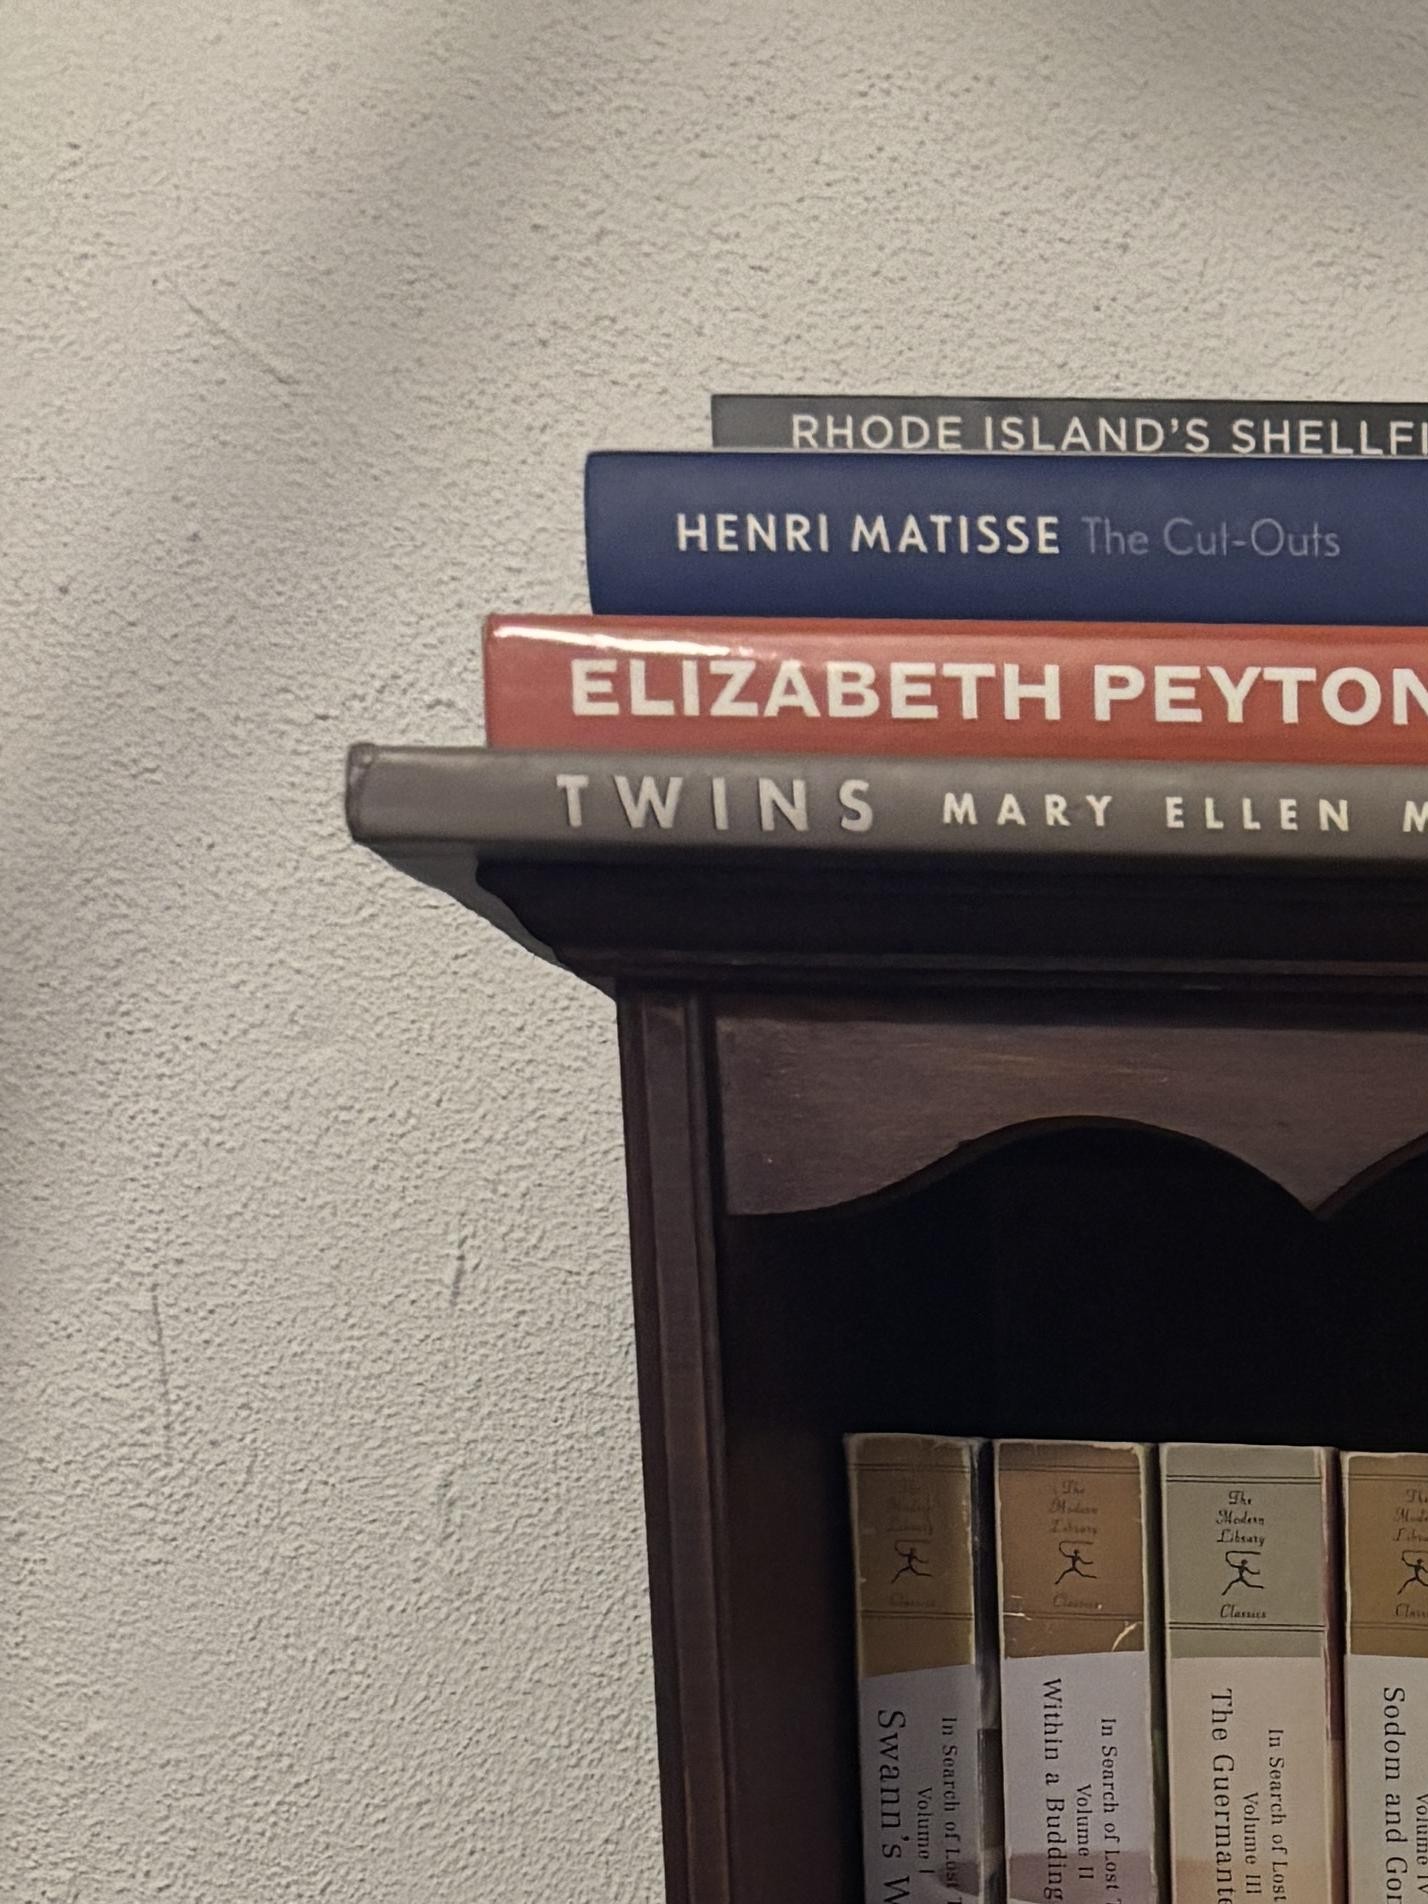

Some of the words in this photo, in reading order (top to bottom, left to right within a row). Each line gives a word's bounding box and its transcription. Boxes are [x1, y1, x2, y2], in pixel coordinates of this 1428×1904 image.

[792, 414, 961, 450] RHODE
[984, 417, 1211, 453] ISLAND'S
[677, 513, 830, 552] HENRI
[851, 515, 1061, 555] MATISSE
[1082, 517, 1149, 556] The
[1163, 517, 1341, 559] Cut-Outs
[570, 658, 1063, 722] ELIZABETH
[556, 773, 874, 833] TWINS
[943, 792, 1114, 829] MARY
[1167, 795, 1350, 833] ELLEN
[1100, 1718, 1117, 1736] In
[1211, 1689, 1233, 1741] The
[876, 1709, 909, 1859] Swann's
[1100, 1746, 1120, 1813] Search
[1103, 1823, 1120, 1842] of
[1105, 1851, 1121, 1893] Lost
